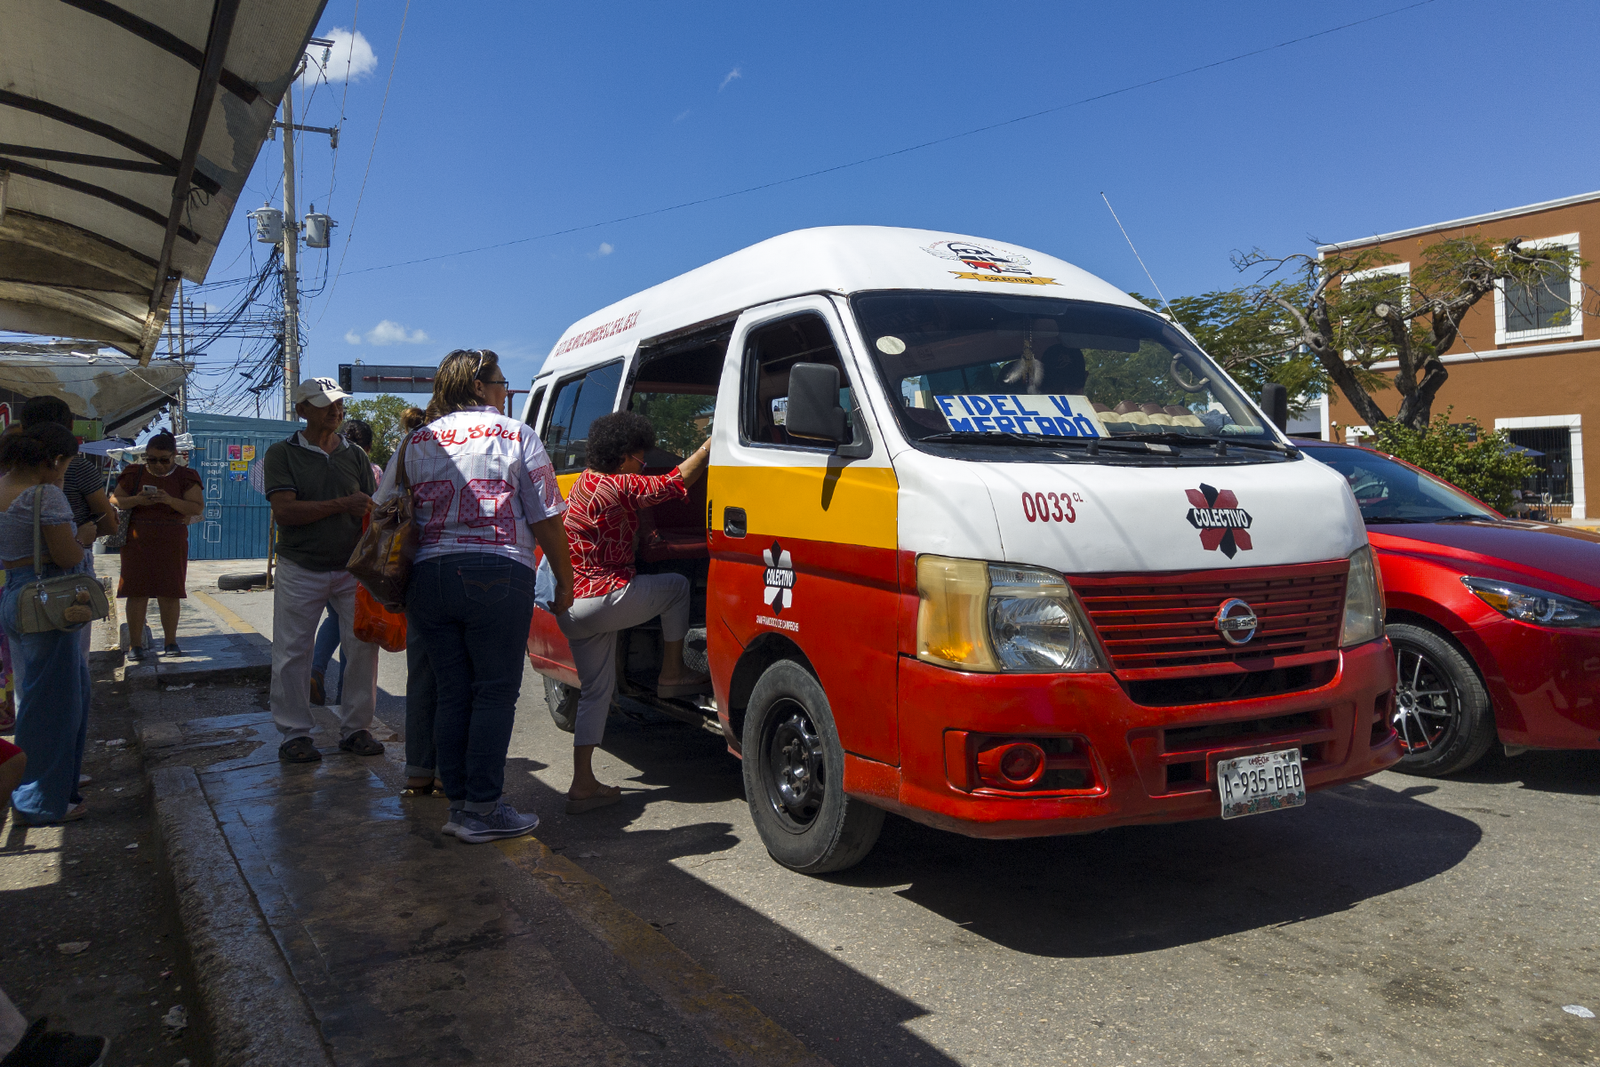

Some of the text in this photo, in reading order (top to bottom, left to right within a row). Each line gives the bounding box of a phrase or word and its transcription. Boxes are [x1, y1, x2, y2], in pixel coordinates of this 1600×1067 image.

[935, 395, 1040, 416] FIDEL
[467, 423, 522, 443] Sweet
[949, 416, 1100, 438] MERCADO
[1021, 491, 1084, 524] 0033 CL
[1193, 508, 1249, 528] COLECTIVO
[766, 568, 793, 587] COLECTIVO
[1224, 763, 1302, 799] A-935-BEB
